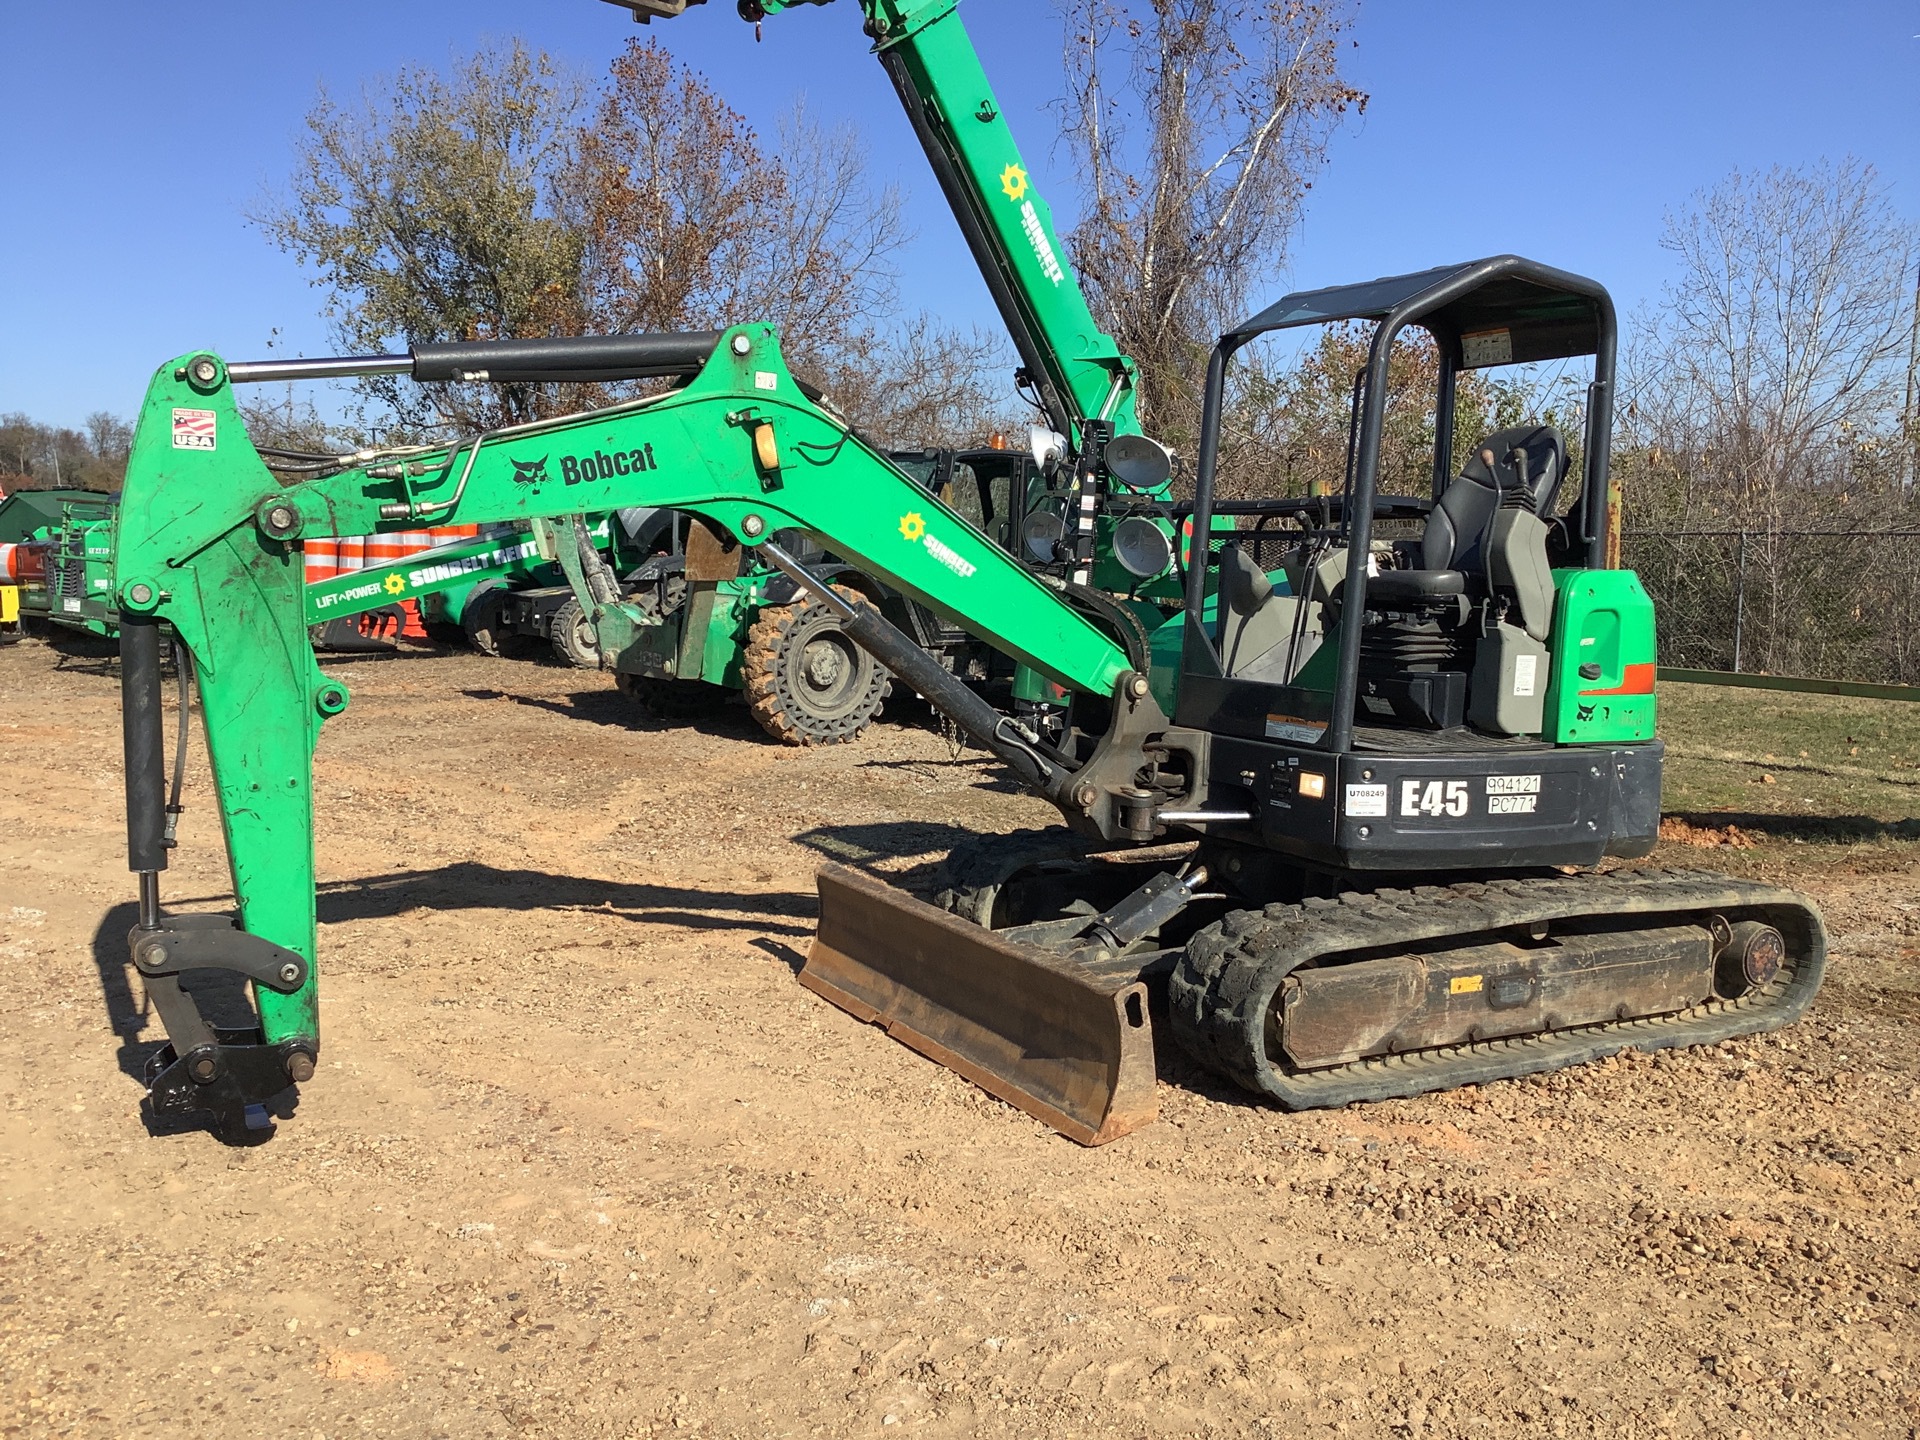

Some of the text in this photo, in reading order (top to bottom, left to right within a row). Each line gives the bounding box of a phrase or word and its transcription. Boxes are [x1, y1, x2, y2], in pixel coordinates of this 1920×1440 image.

[1021, 199, 1064, 284] SUNBELT
[174, 435, 213, 447] USA
[559, 442, 658, 486] Bobcat
[408, 552, 490, 588] SUNBELT
[492, 540, 540, 566] RENT
[923, 533, 978, 578] SUNBELT
[1400, 780, 1469, 817] E45
[1487, 776, 1539, 793] 994121
[1491, 796, 1534, 812] PC771
